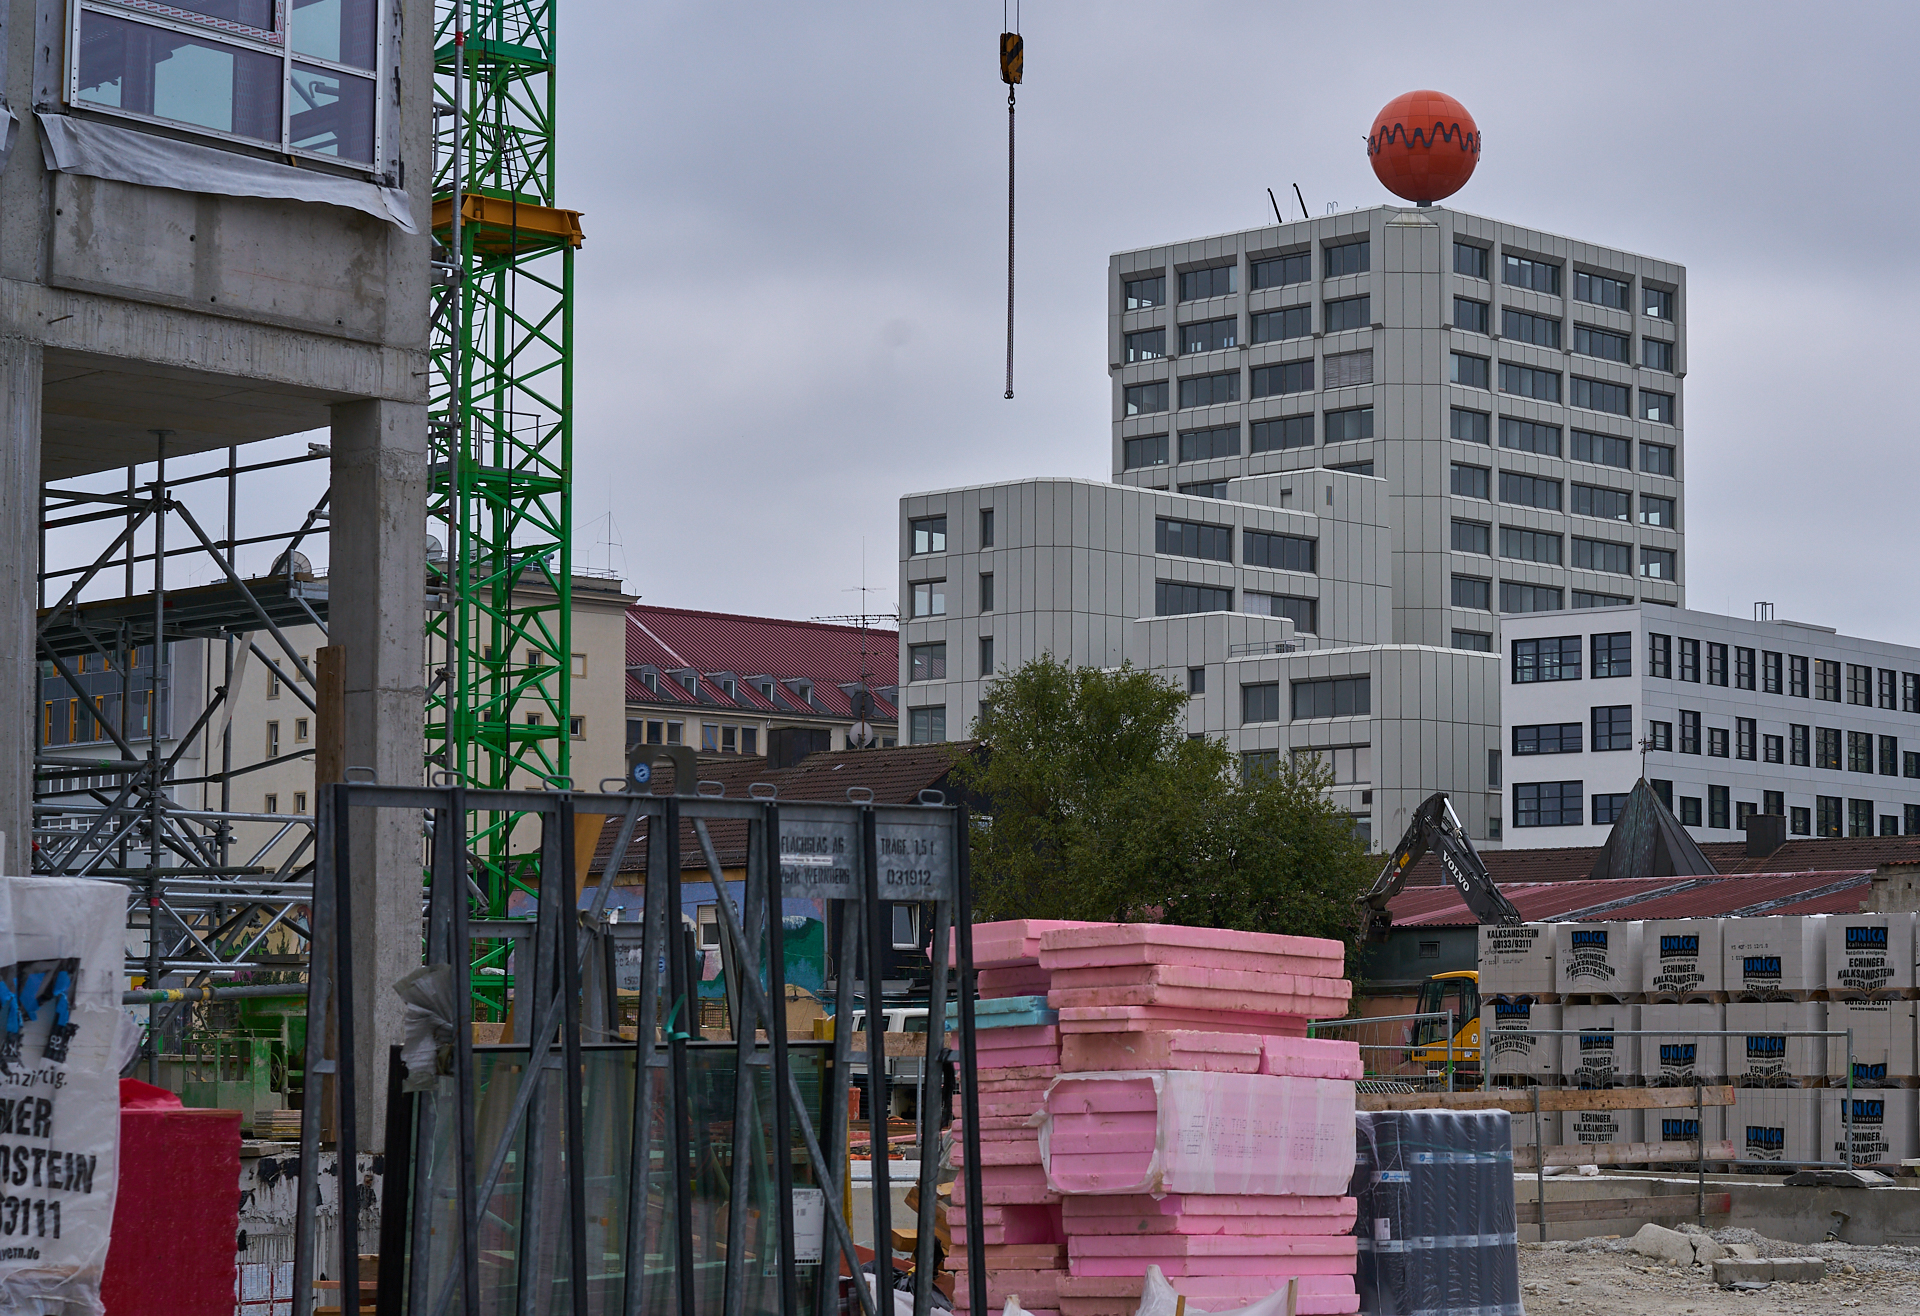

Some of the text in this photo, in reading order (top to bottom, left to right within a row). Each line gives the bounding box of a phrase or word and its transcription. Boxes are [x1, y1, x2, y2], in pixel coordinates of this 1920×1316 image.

[1443, 850, 1470, 891] VOLVO
[887, 869, 931, 886] 031912
[1492, 940, 1532, 949] 08133/93111
[1849, 957, 1885, 968] ECHINGER
[1663, 964, 1696, 974] ECHINGER
[1838, 968, 1895, 980] KALKSANDSTEIN
[1750, 1064, 1782, 1077] ECHINGER
[1581, 1113, 1611, 1123] ECHINGER
[1573, 1124, 1619, 1133] KALKSANDSTEIN
[1835, 1142, 1889, 1153] KALSANDSTEIN
[1840, 1153, 1881, 1164] 0833/93111
[0, 1196, 61, 1239] 3111
